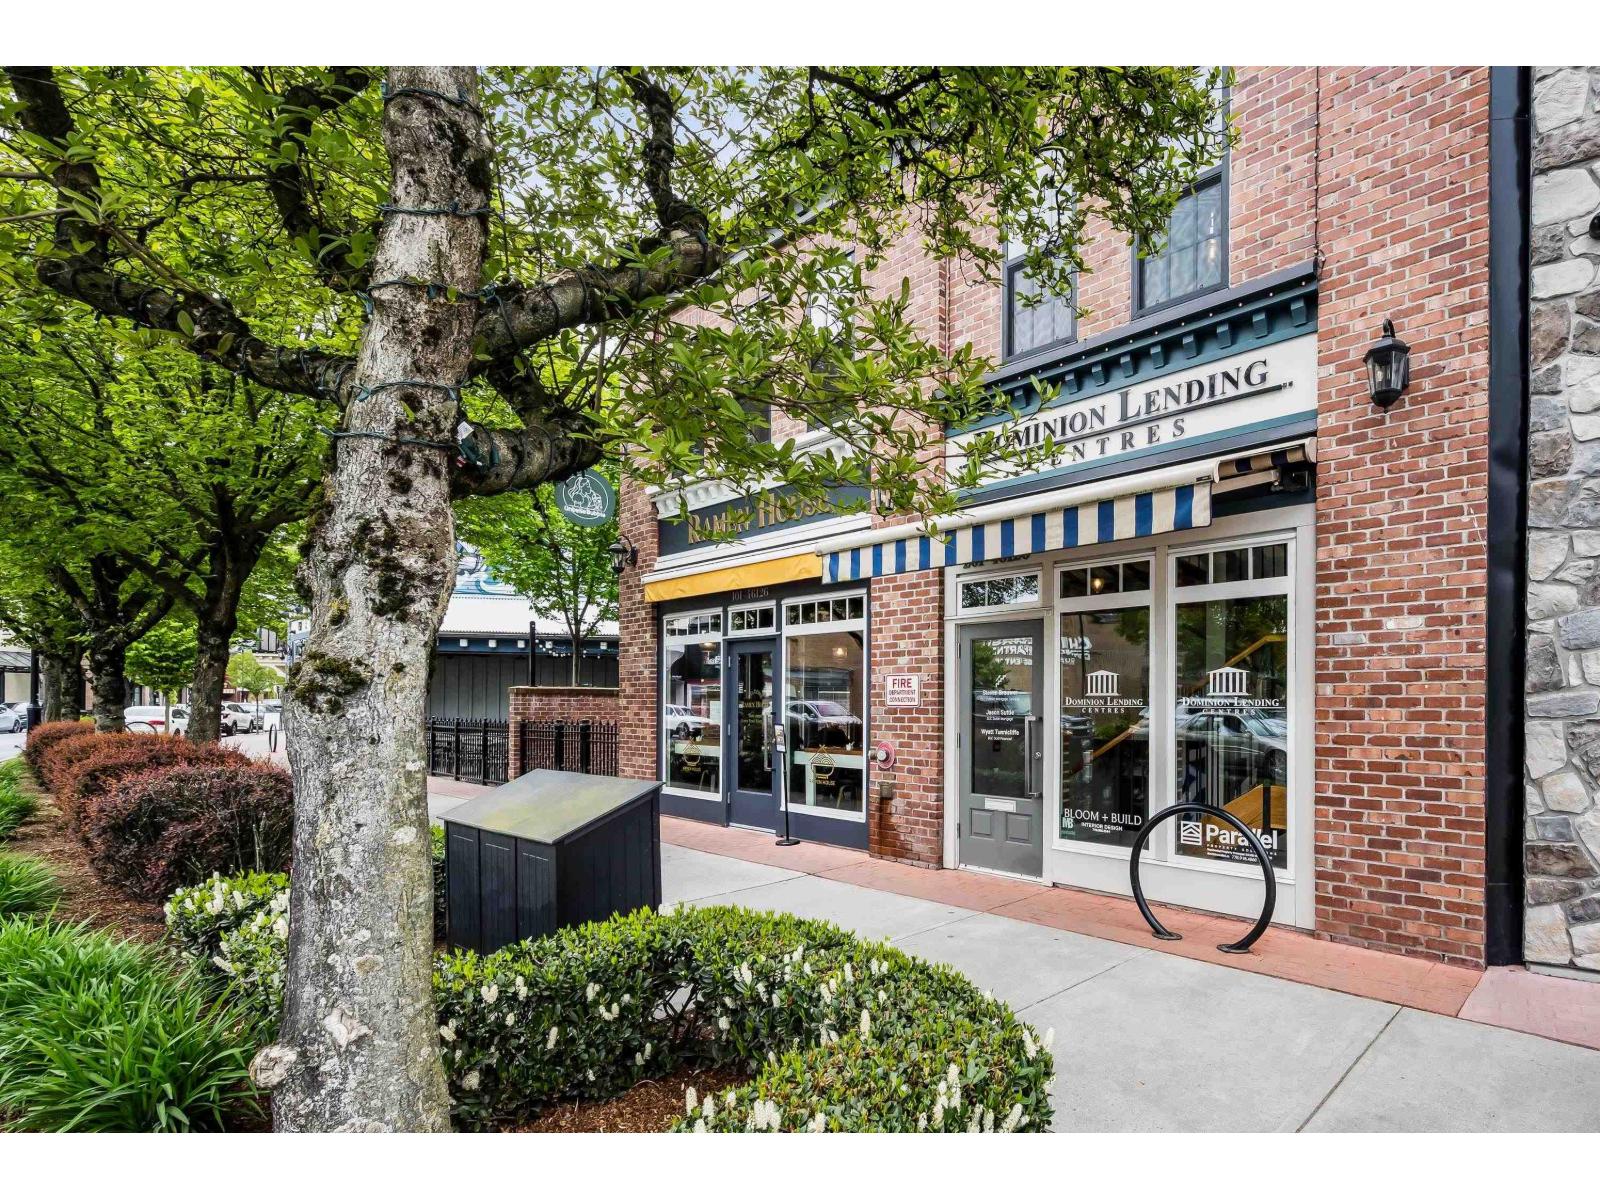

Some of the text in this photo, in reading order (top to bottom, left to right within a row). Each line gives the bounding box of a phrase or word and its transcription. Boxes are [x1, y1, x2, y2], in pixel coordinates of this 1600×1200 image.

[974, 359, 1268, 455] MINION LENDING
[1048, 418, 1185, 467] ENTRES
[892, 678, 912, 689] FIRE
[1065, 696, 1144, 706] DOMINION LENDING
[1182, 696, 1280, 707] DOMINION LENDING
[1202, 708, 1256, 716] CENTRES
[1064, 808, 1142, 826] BLOOM + BUILD
[1205, 824, 1278, 850] Parael
